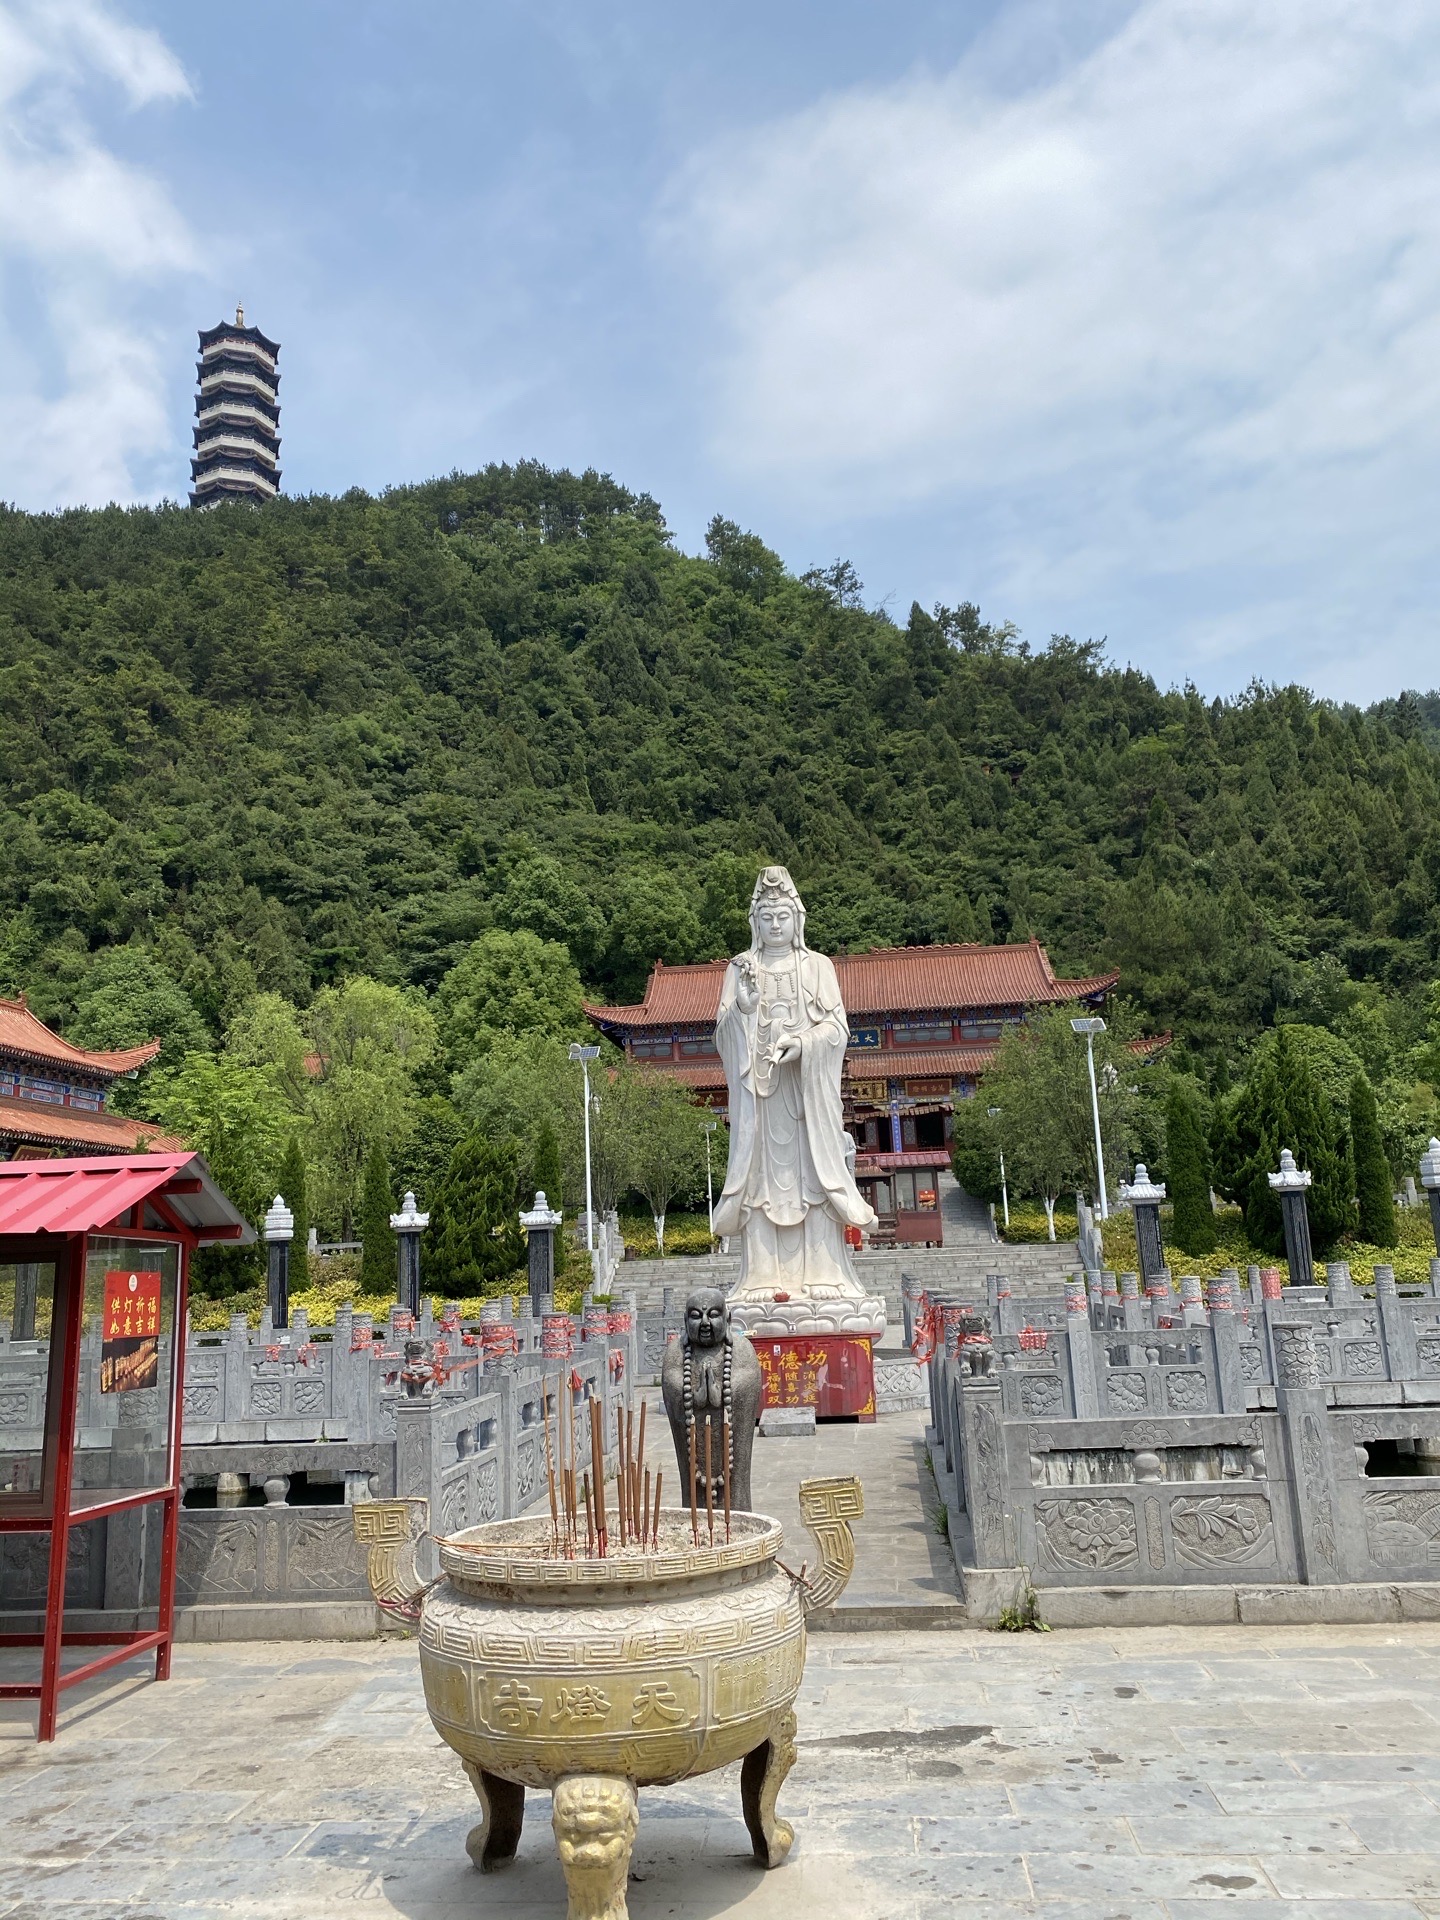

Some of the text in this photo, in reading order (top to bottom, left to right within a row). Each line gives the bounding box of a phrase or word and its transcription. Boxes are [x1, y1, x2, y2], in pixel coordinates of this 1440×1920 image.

[111, 1296, 157, 1315] 供灯祈福
[110, 1315, 156, 1336] 如意吉祥
[757, 1350, 827, 1371] 功德箱
[767, 1373, 783, 1408] 福慧双
[785, 1371, 800, 1408] 随喜功
[802, 1370, 820, 1409] 消灾延
[493, 1678, 685, 1732] 天燈寺
